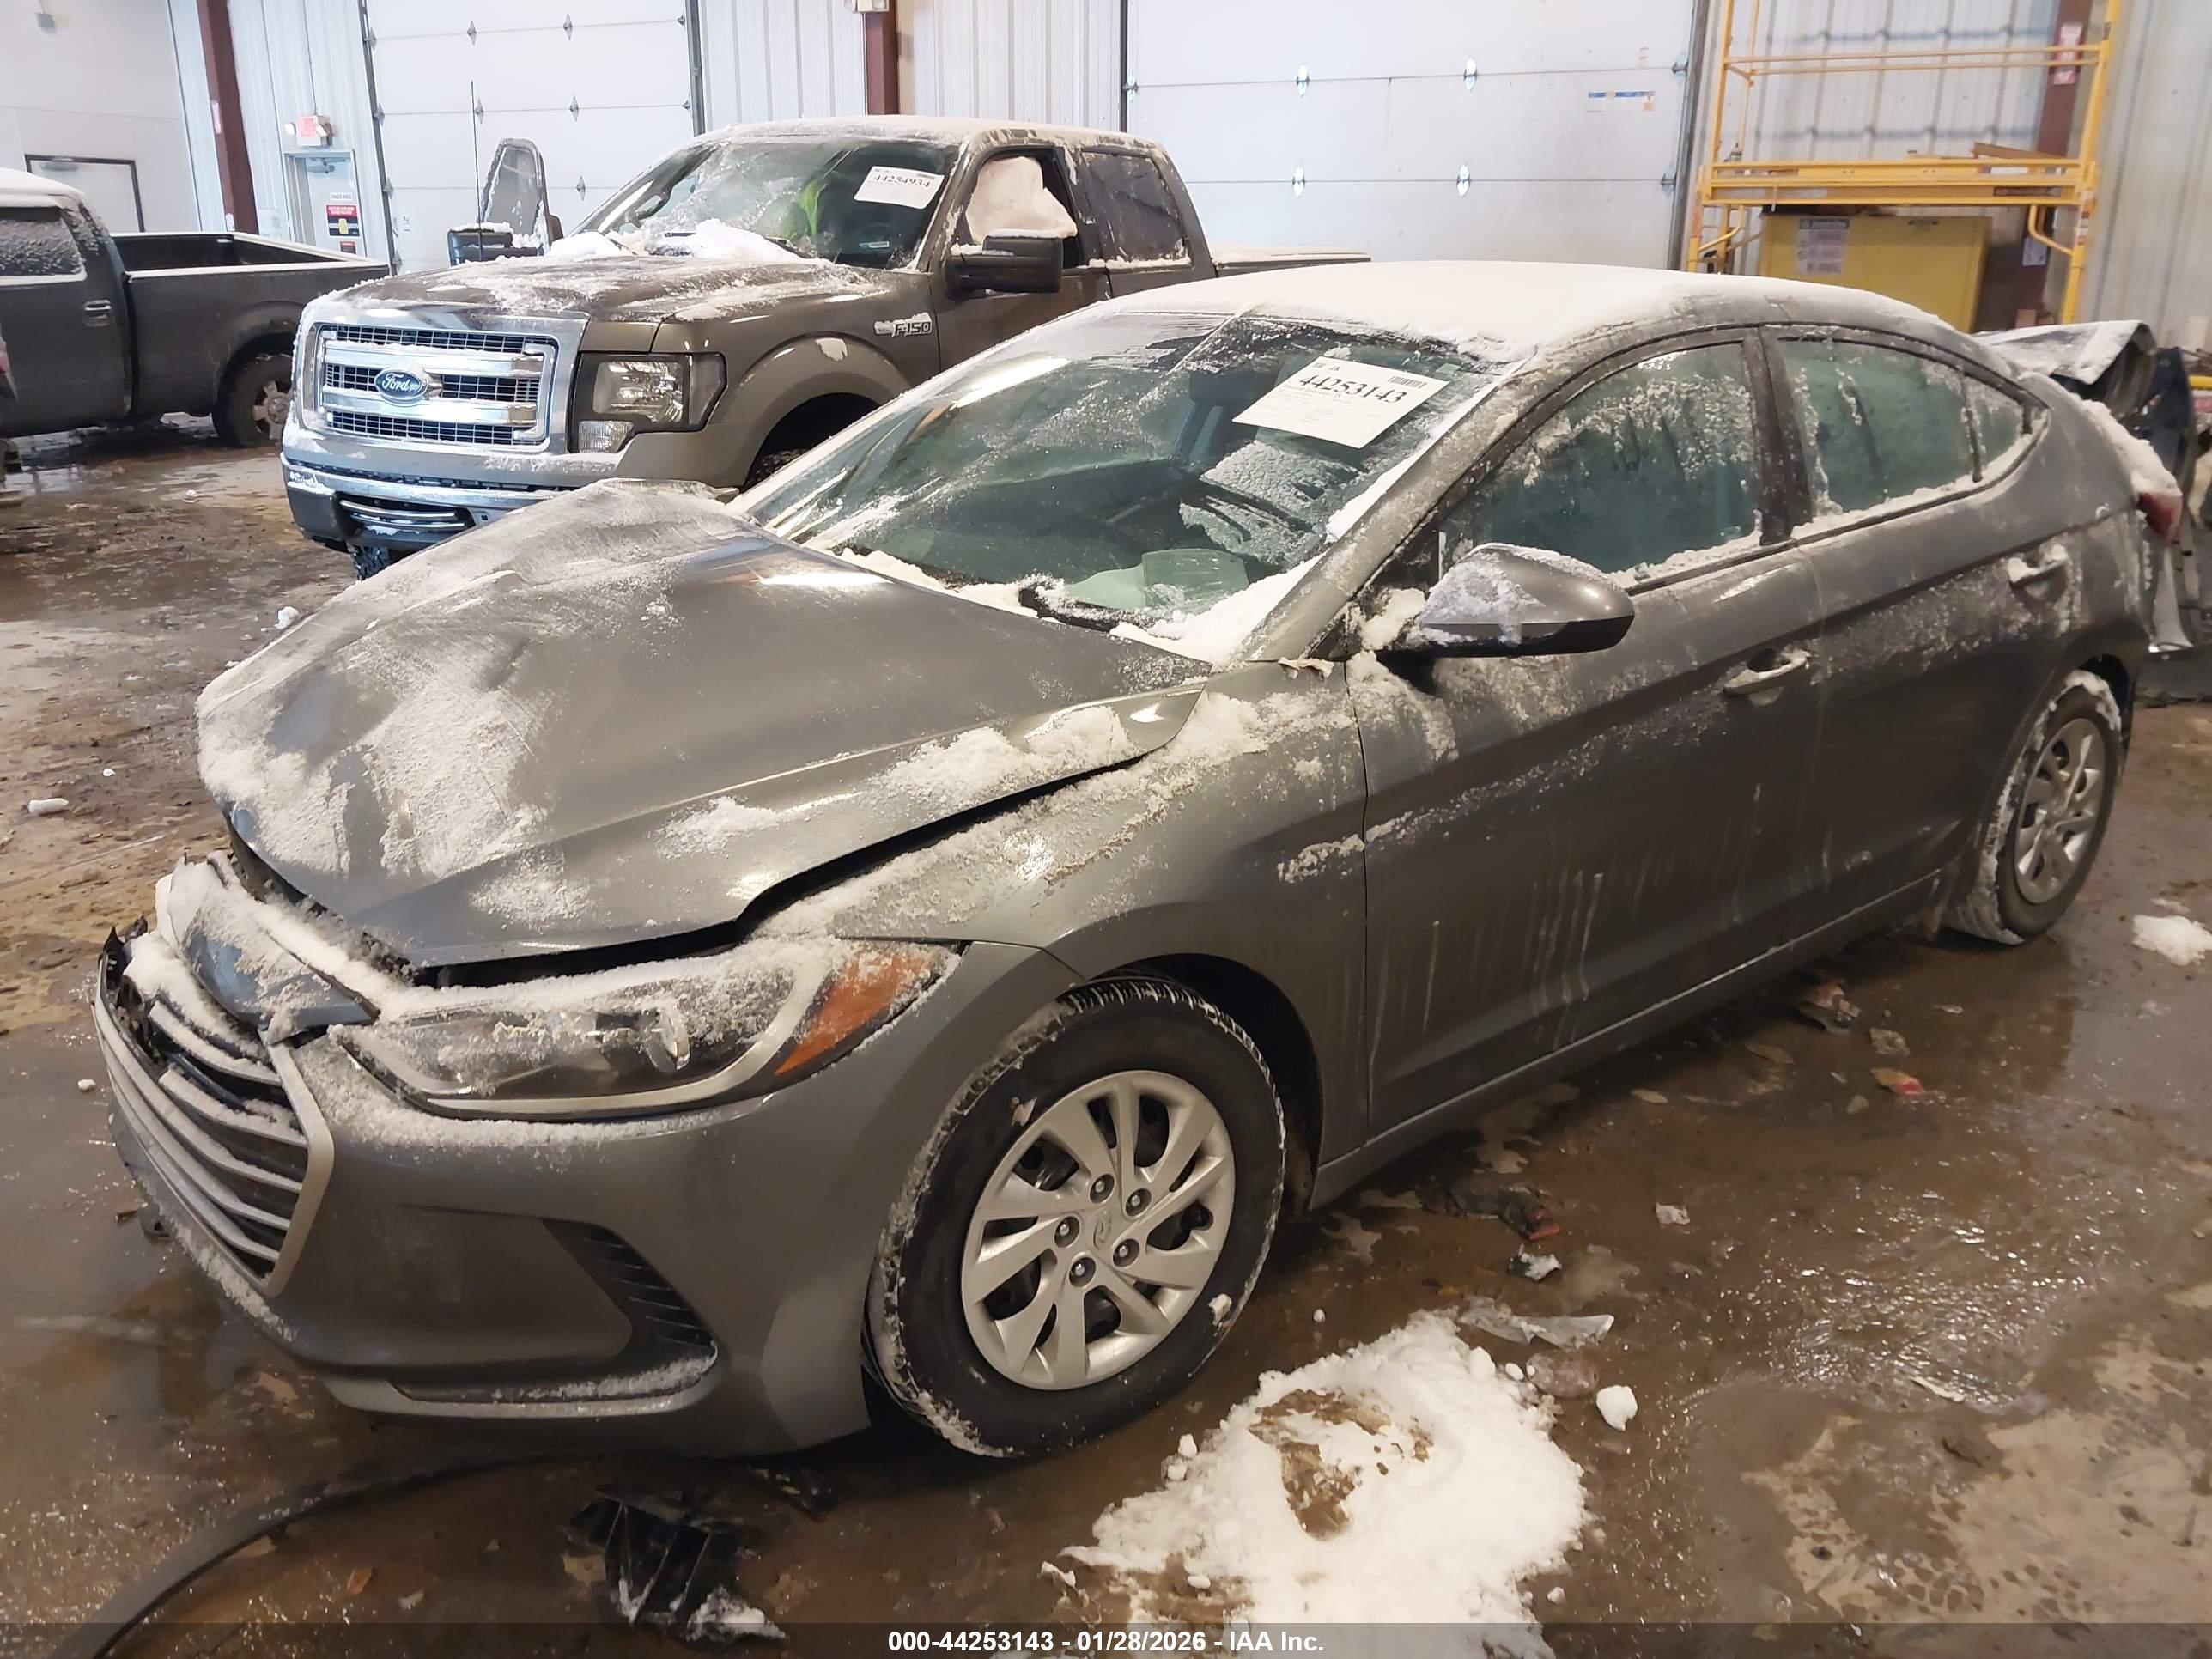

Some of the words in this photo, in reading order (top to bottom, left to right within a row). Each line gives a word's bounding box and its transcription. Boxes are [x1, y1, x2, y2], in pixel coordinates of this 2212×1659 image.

[873, 174, 931, 188] 44254934
[382, 372, 410, 392] Ford
[1298, 374, 1408, 404] 44253143
